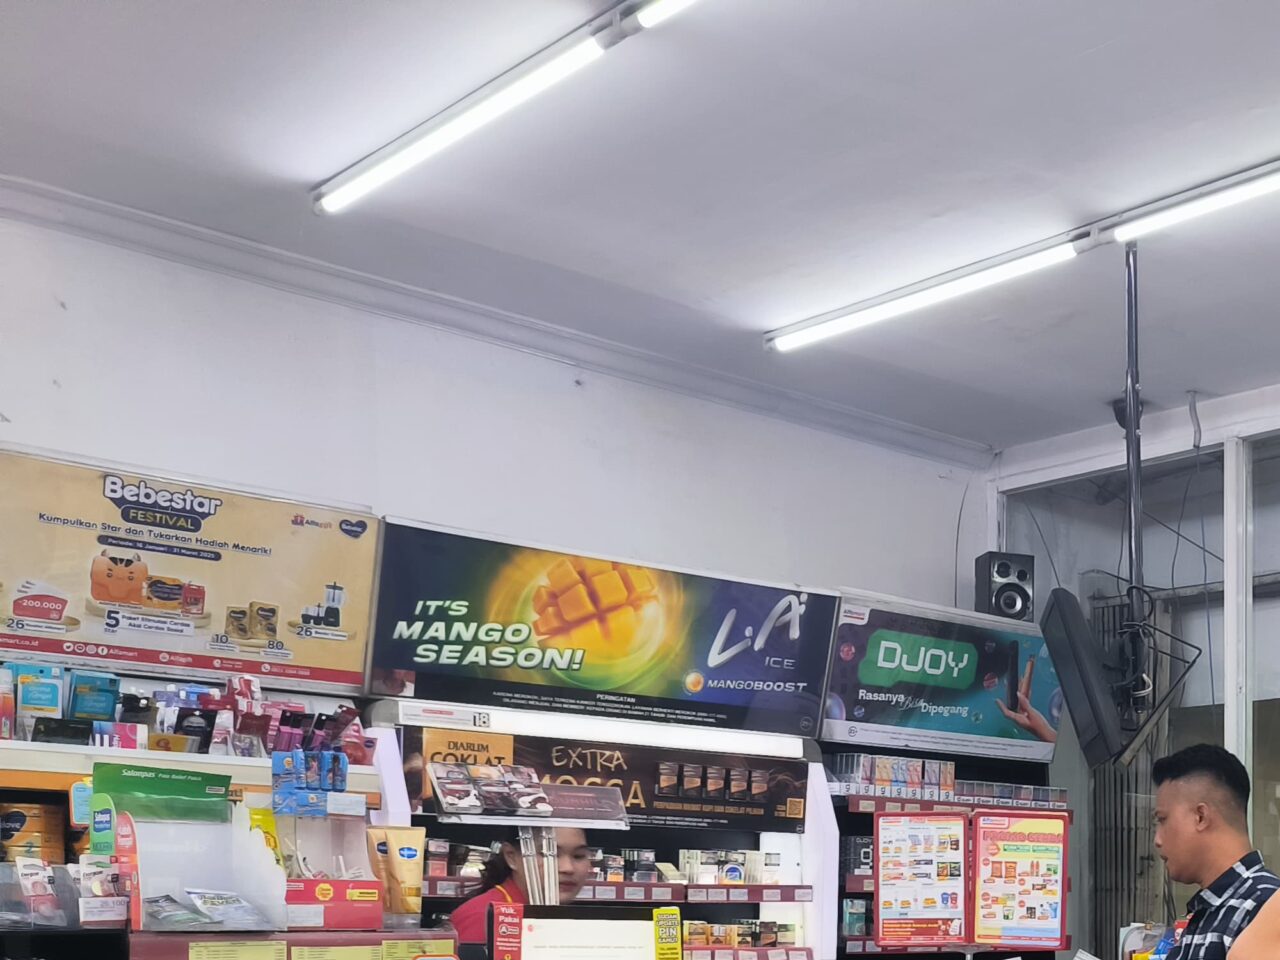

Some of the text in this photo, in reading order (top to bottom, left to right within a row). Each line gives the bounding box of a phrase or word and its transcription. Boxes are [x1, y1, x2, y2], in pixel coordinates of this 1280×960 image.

[104, 474, 222, 515] Bebestar
[129, 509, 195, 529] FESTIVAL
[38, 512, 98, 530] Kumpulkan
[101, 522, 122, 533] Star
[125, 526, 144, 536] dan
[148, 529, 192, 544] Tukarkan
[195, 537, 229, 549] Hadiah
[414, 600, 469, 617] IT'S
[7, 617, 25, 630] 26
[105, 609, 120, 628] 5
[215, 634, 228, 644] 10
[296, 626, 313, 637] 26
[393, 619, 532, 643] MANGO
[267, 640, 284, 650] 80
[413, 644, 586, 671] SEASON!
[764, 656, 795, 670] ICE
[877, 640, 968, 678] DJOY
[706, 679, 807, 694] MANGOBOOST
[858, 689, 969, 717] Rasanya Dipegang
[447, 740, 490, 754] DJARUM
[551, 745, 628, 772] EXTRA
[122, 768, 155, 778] Salonpas
